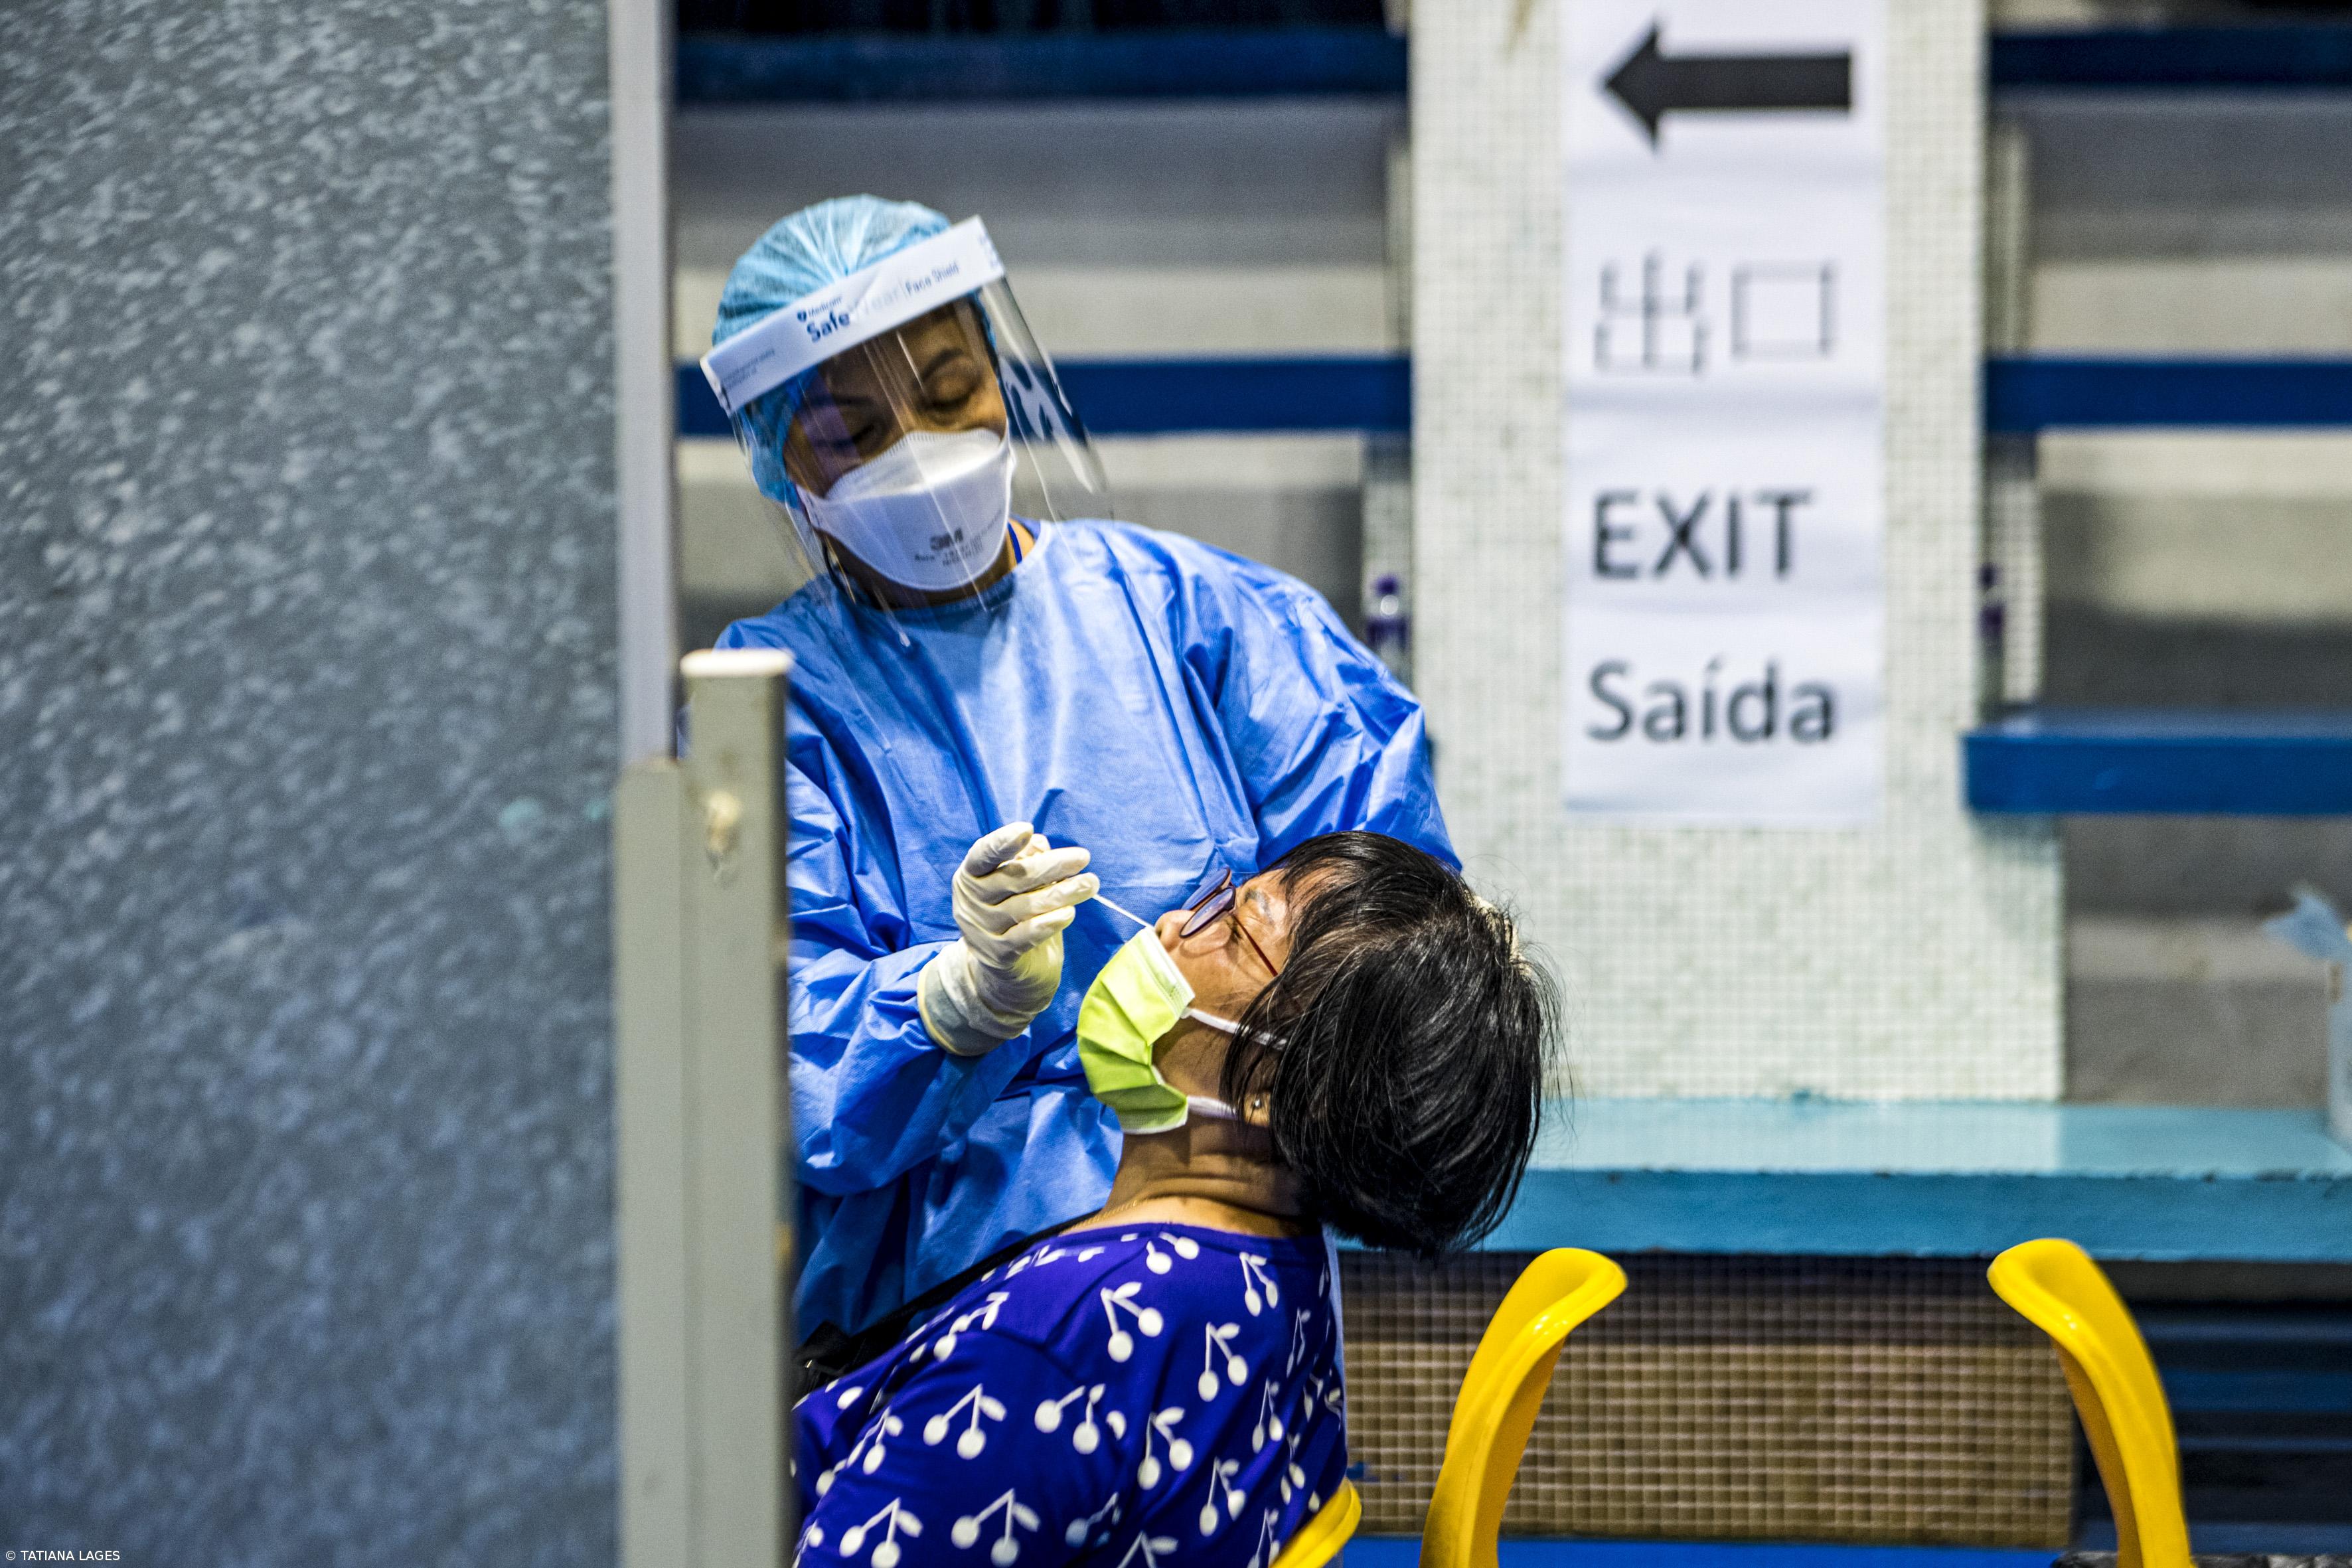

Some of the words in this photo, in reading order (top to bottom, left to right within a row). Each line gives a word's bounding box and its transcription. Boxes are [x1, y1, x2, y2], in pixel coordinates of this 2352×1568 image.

[905, 276, 931, 295] Face
[931, 260, 960, 282] Shield
[1592, 249, 1839, 376] 出口
[930, 527, 963, 550] 3M
[1591, 488, 1815, 580] EXIT
[1585, 653, 1838, 744] Saída
